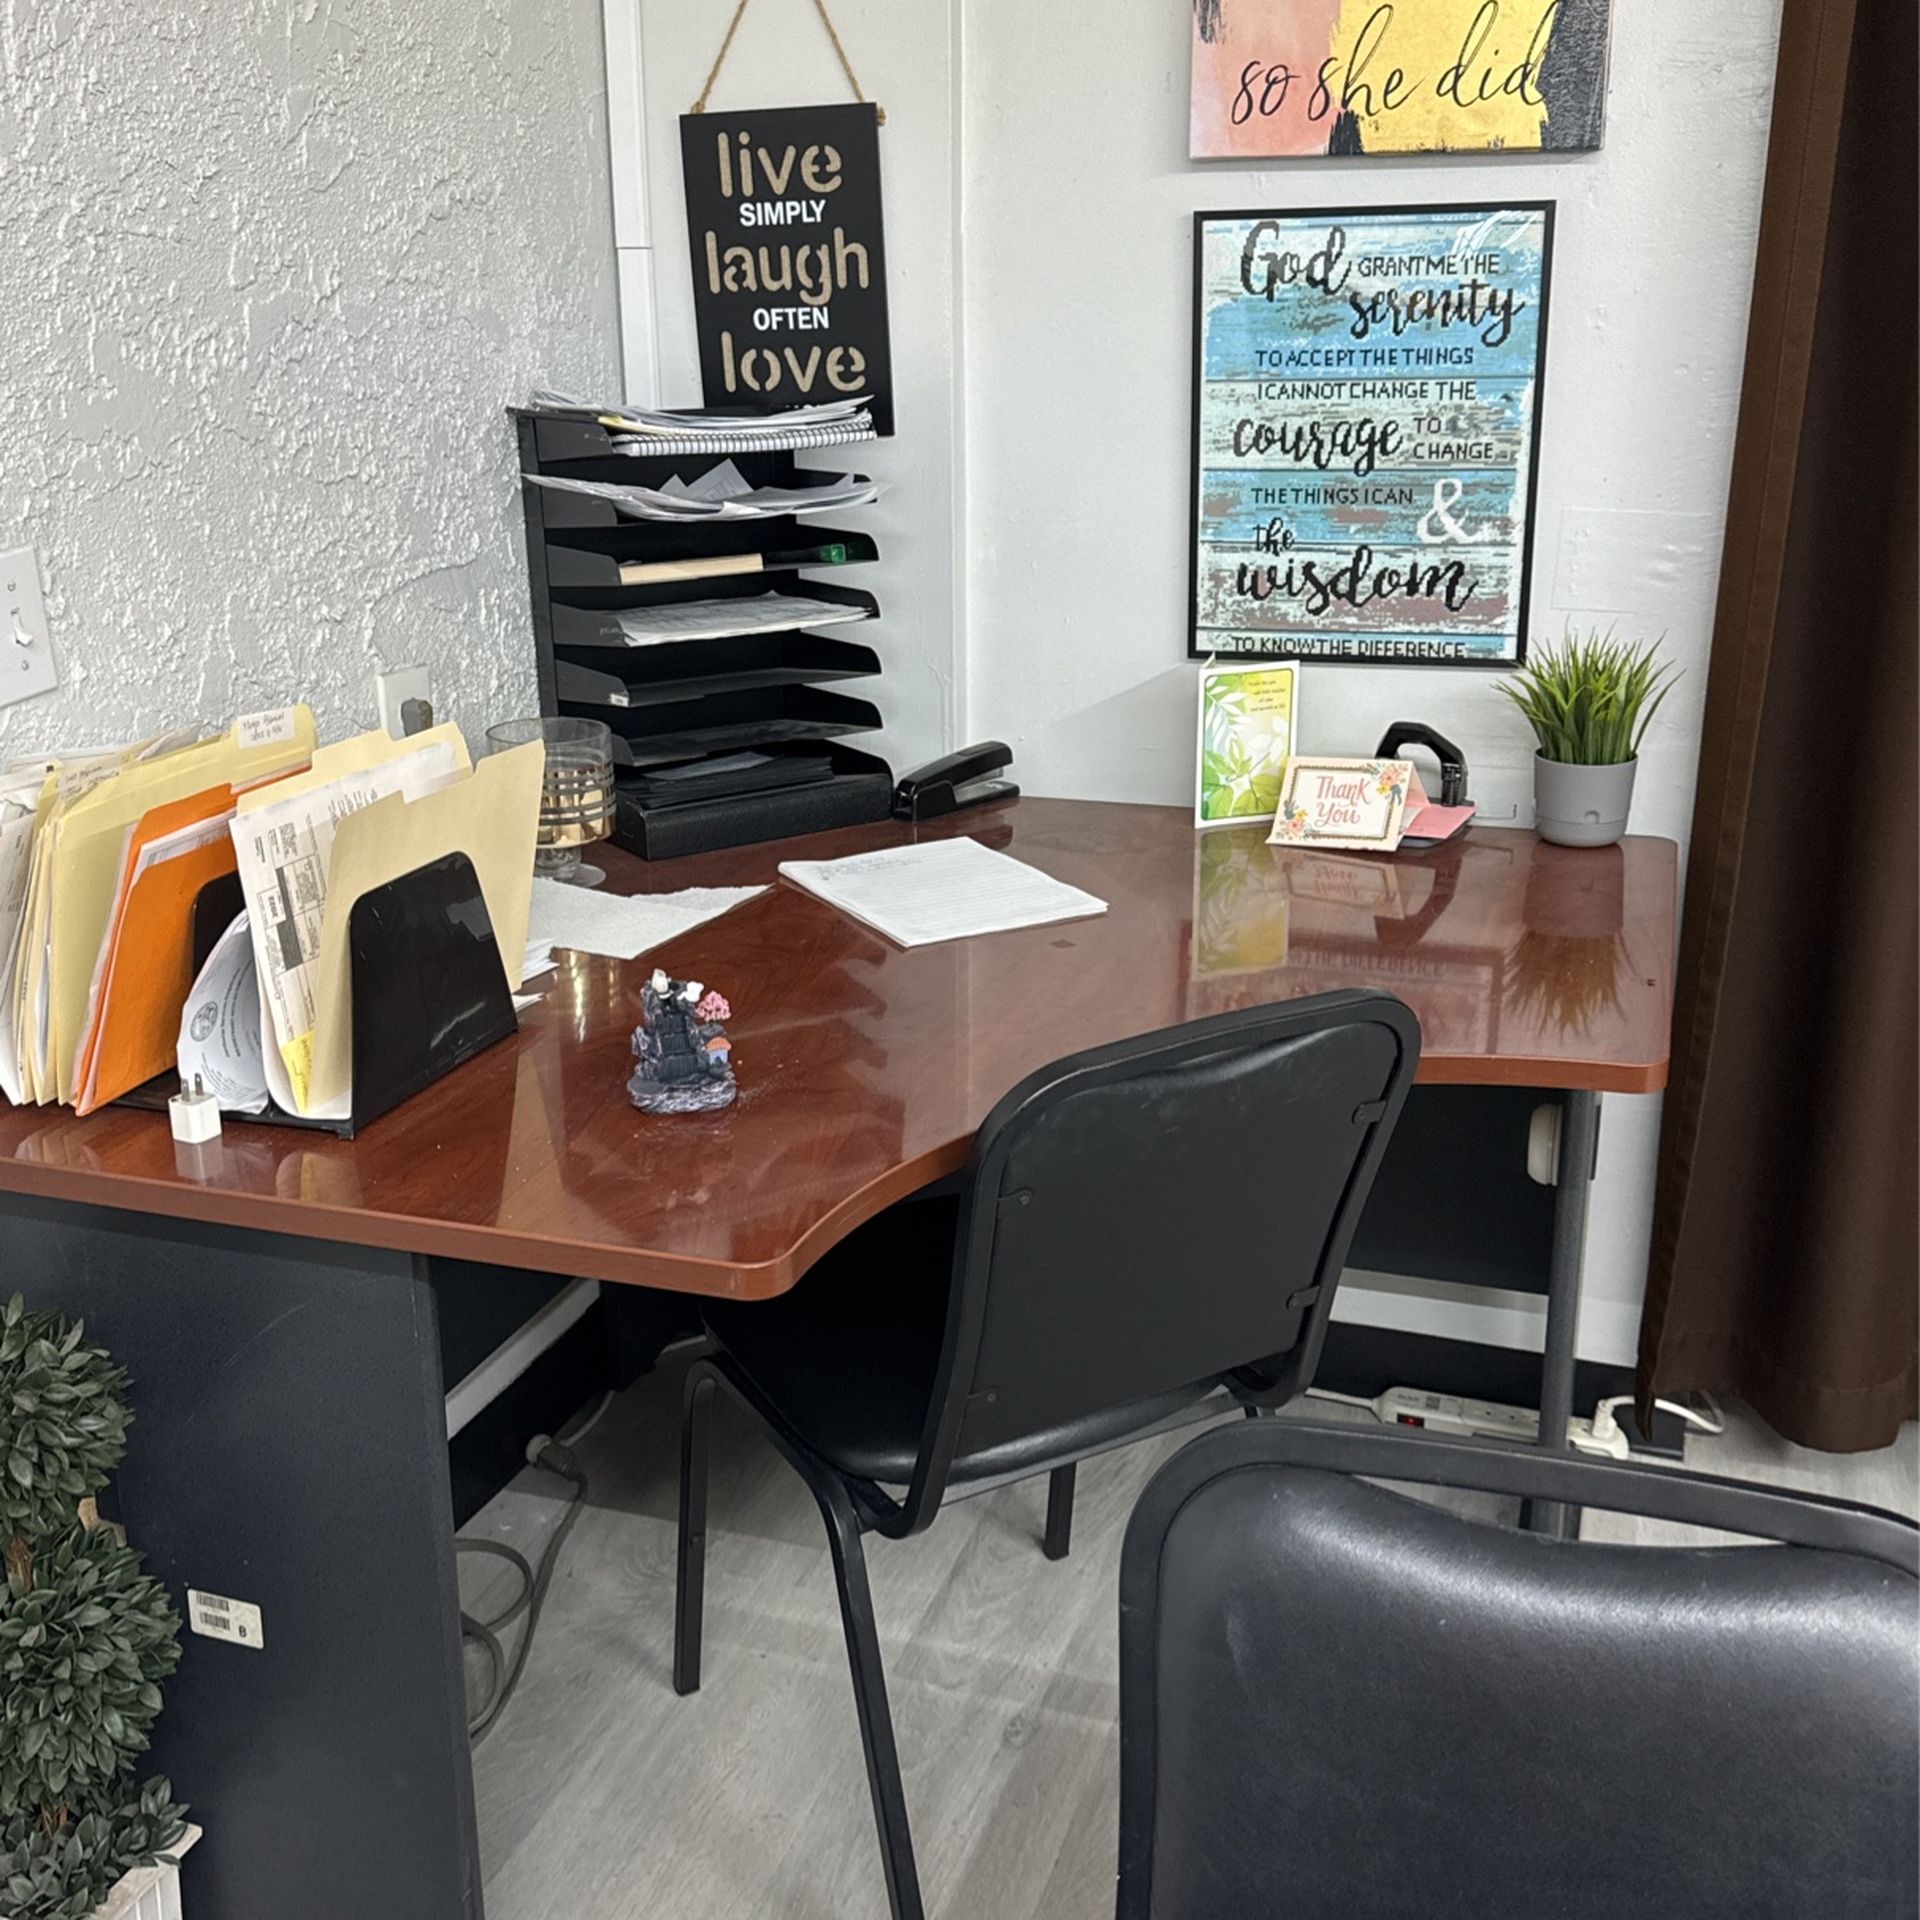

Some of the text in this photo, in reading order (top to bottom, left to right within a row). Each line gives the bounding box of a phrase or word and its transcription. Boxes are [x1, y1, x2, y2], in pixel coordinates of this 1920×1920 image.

[1231, 0, 1563, 125] so she did
[717, 131, 843, 198] live
[740, 200, 825, 226] SIMPLY
[705, 227, 869, 306] laugh
[1240, 220, 1352, 302] God
[1358, 253, 1500, 277] GRANT ME THE
[753, 307, 829, 331] OFTEN
[1348, 279, 1526, 347] serenity
[721, 331, 865, 393] love
[1256, 347, 1474, 367] TO ACCEPT THE THINGS
[1257, 381, 1477, 400] I CANNOT CHANGE THE
[1413, 417, 1441, 434] TO
[1233, 417, 1402, 476] courage
[1413, 442, 1493, 460] CHANGE
[1252, 488, 1287, 504] THE
[1290, 488, 1358, 504] THINGS
[1372, 488, 1413, 504] CAN
[1416, 478, 1484, 544] &
[1252, 517, 1294, 556] the
[1236, 545, 1479, 615] wisdom
[1231, 637, 1467, 658] TO KNOW THE DIFFERENCE
[1316, 776, 1372, 807] Thank
[1314, 803, 1361, 828] You
